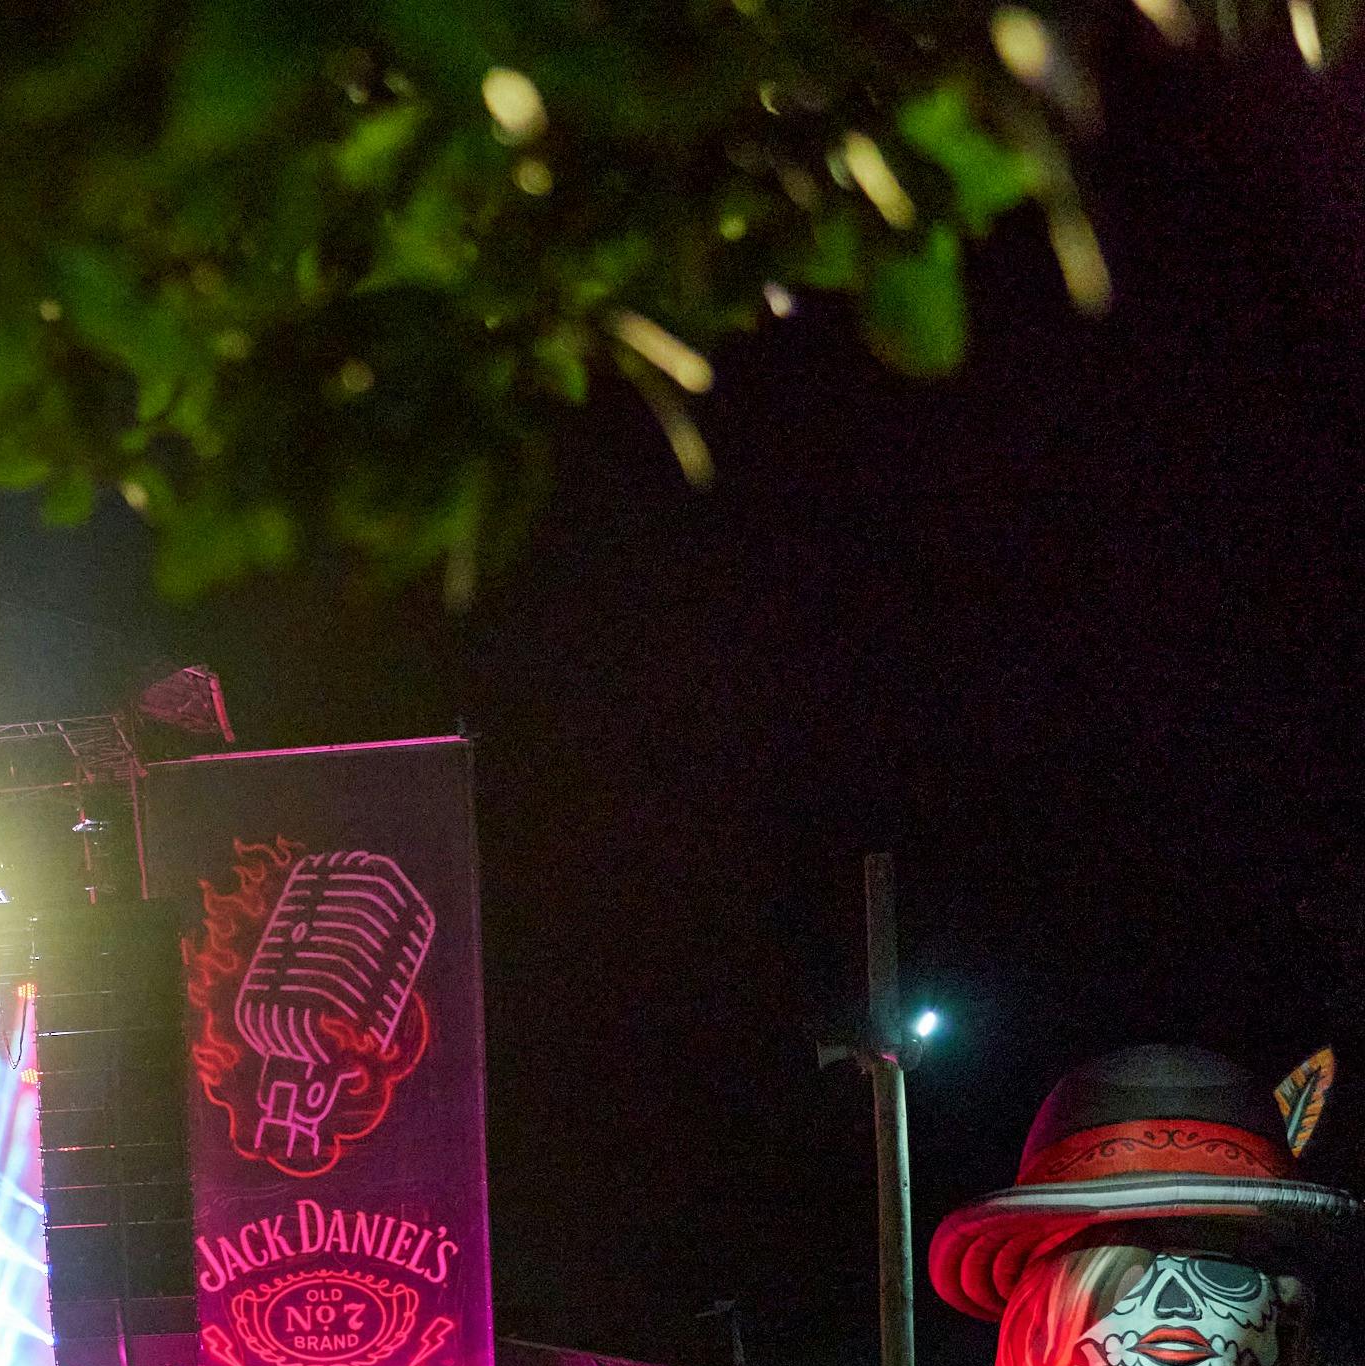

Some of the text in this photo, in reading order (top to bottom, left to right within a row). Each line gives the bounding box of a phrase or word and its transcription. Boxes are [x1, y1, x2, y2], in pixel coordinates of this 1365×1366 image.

[196, 1200, 460, 1292] JACK DANIEL'S
[305, 1288, 343, 1303] OLD
[343, 1303, 366, 1332] 7
[294, 1333, 360, 1352] BRAND
